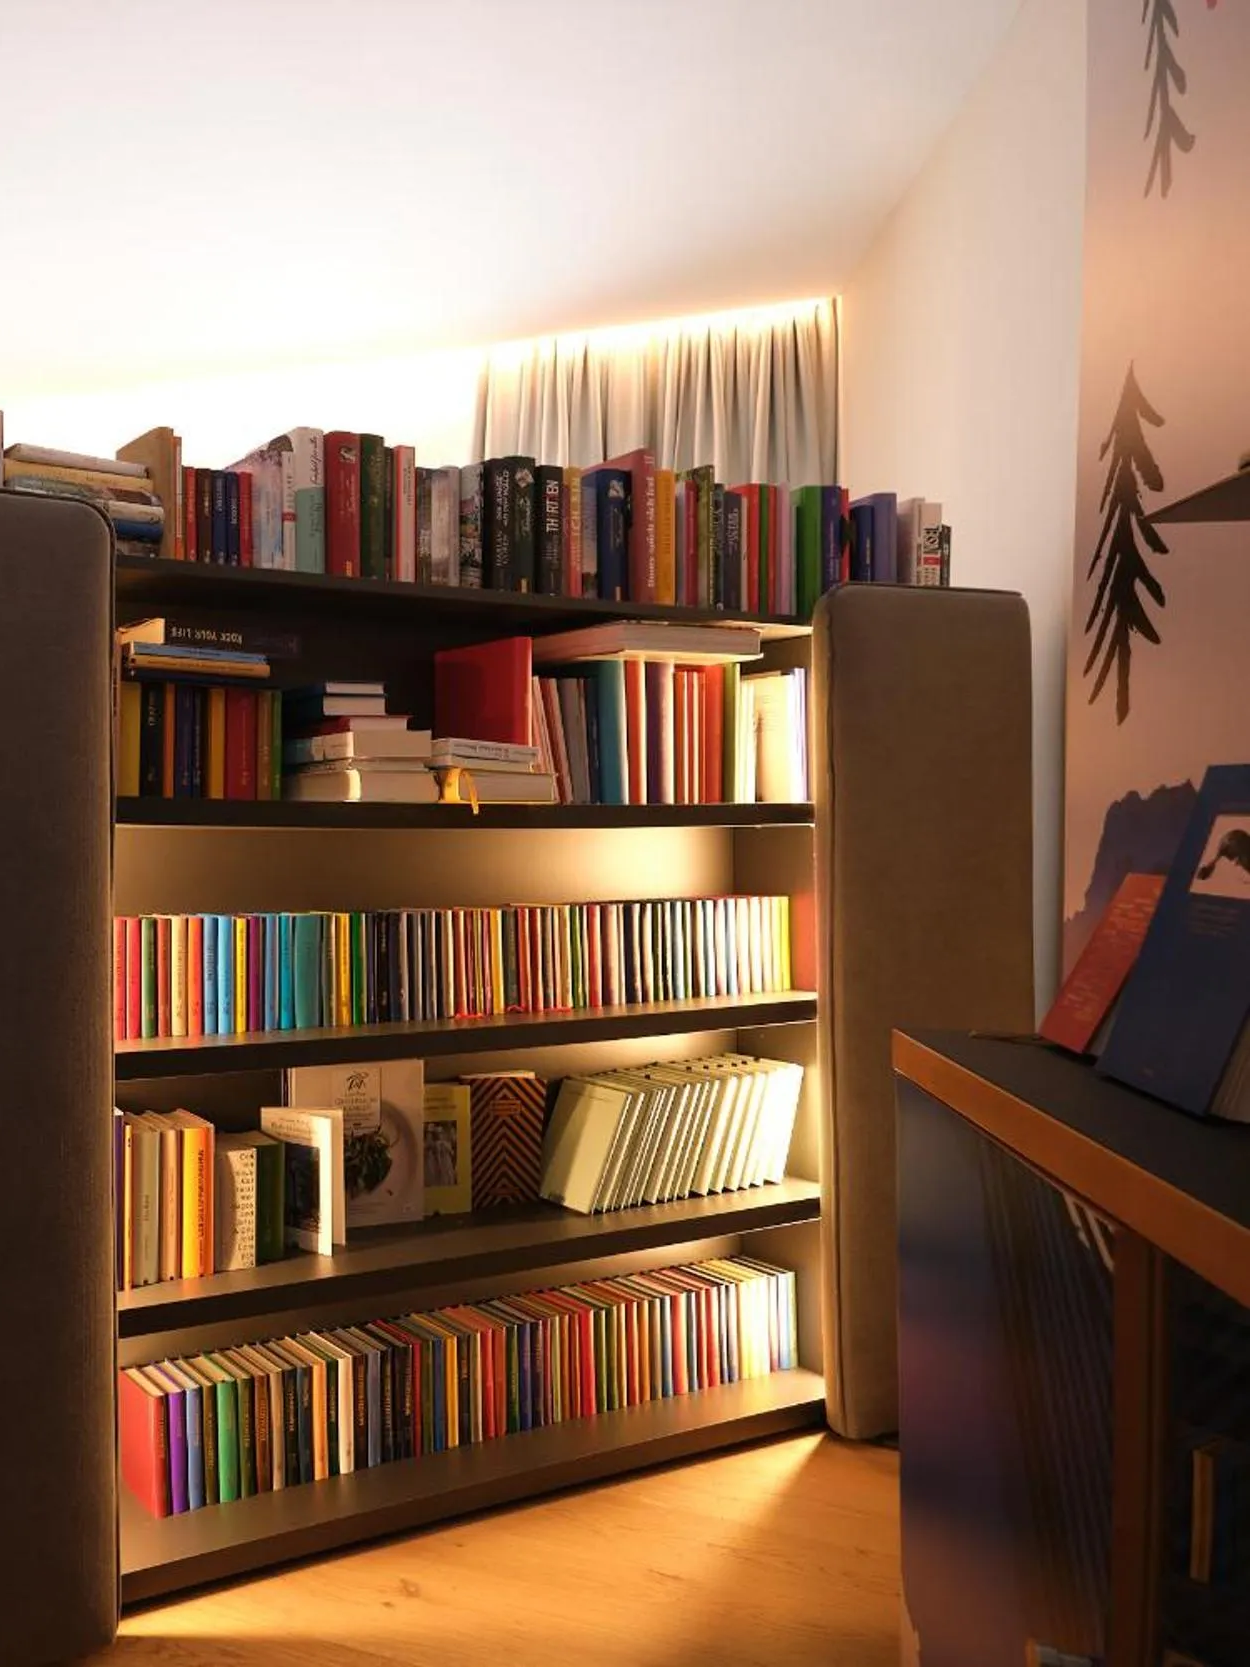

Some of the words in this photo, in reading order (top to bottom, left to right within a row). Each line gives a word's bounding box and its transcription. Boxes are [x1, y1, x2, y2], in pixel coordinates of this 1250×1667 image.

[171, 626, 191, 639] LIFE
[195, 629, 217, 641] YOUR
[220, 631, 242, 645] ROCK
